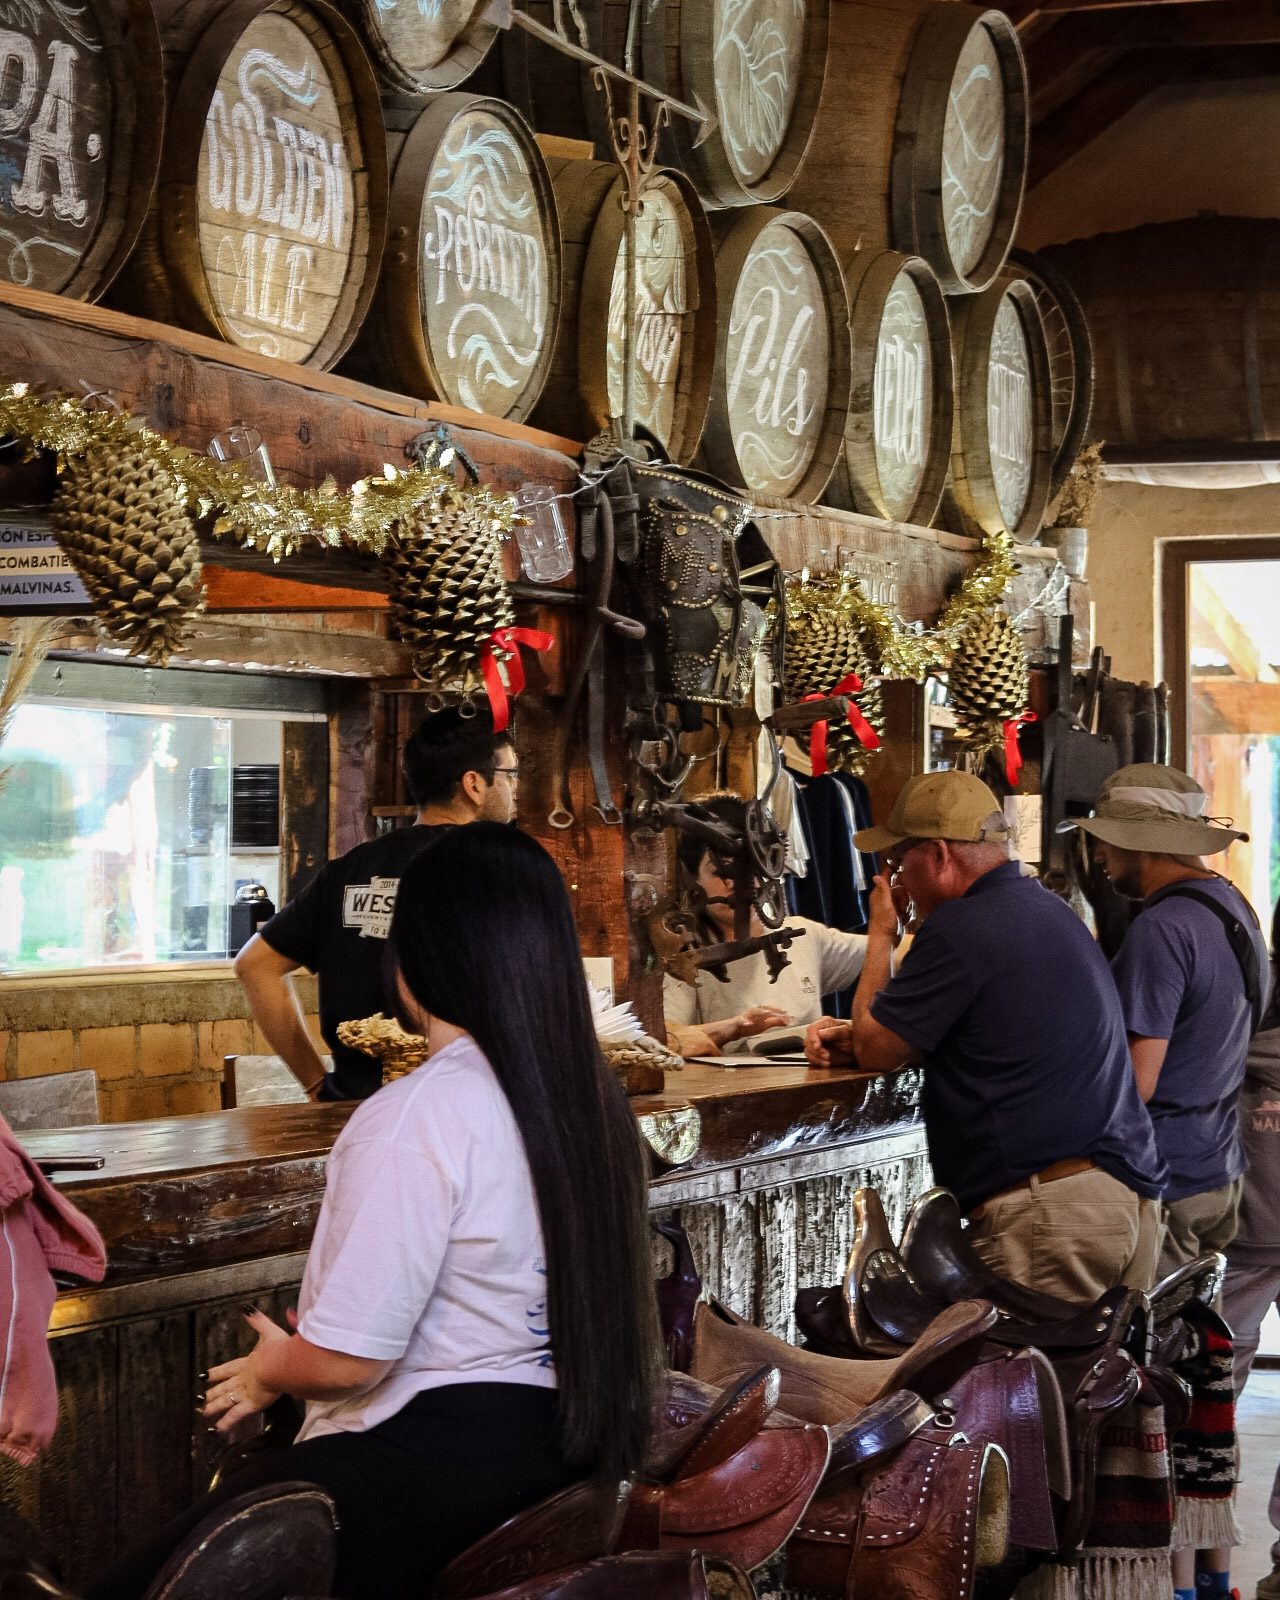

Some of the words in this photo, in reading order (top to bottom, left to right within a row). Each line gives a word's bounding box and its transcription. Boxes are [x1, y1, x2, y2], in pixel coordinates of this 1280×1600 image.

[206, 88, 345, 249] GOLDEN
[217, 229, 314, 334] ALE
[424, 184, 543, 333] PORTER
[728, 286, 817, 435] Pils
[0, 581, 75, 595] MALVINAS.
